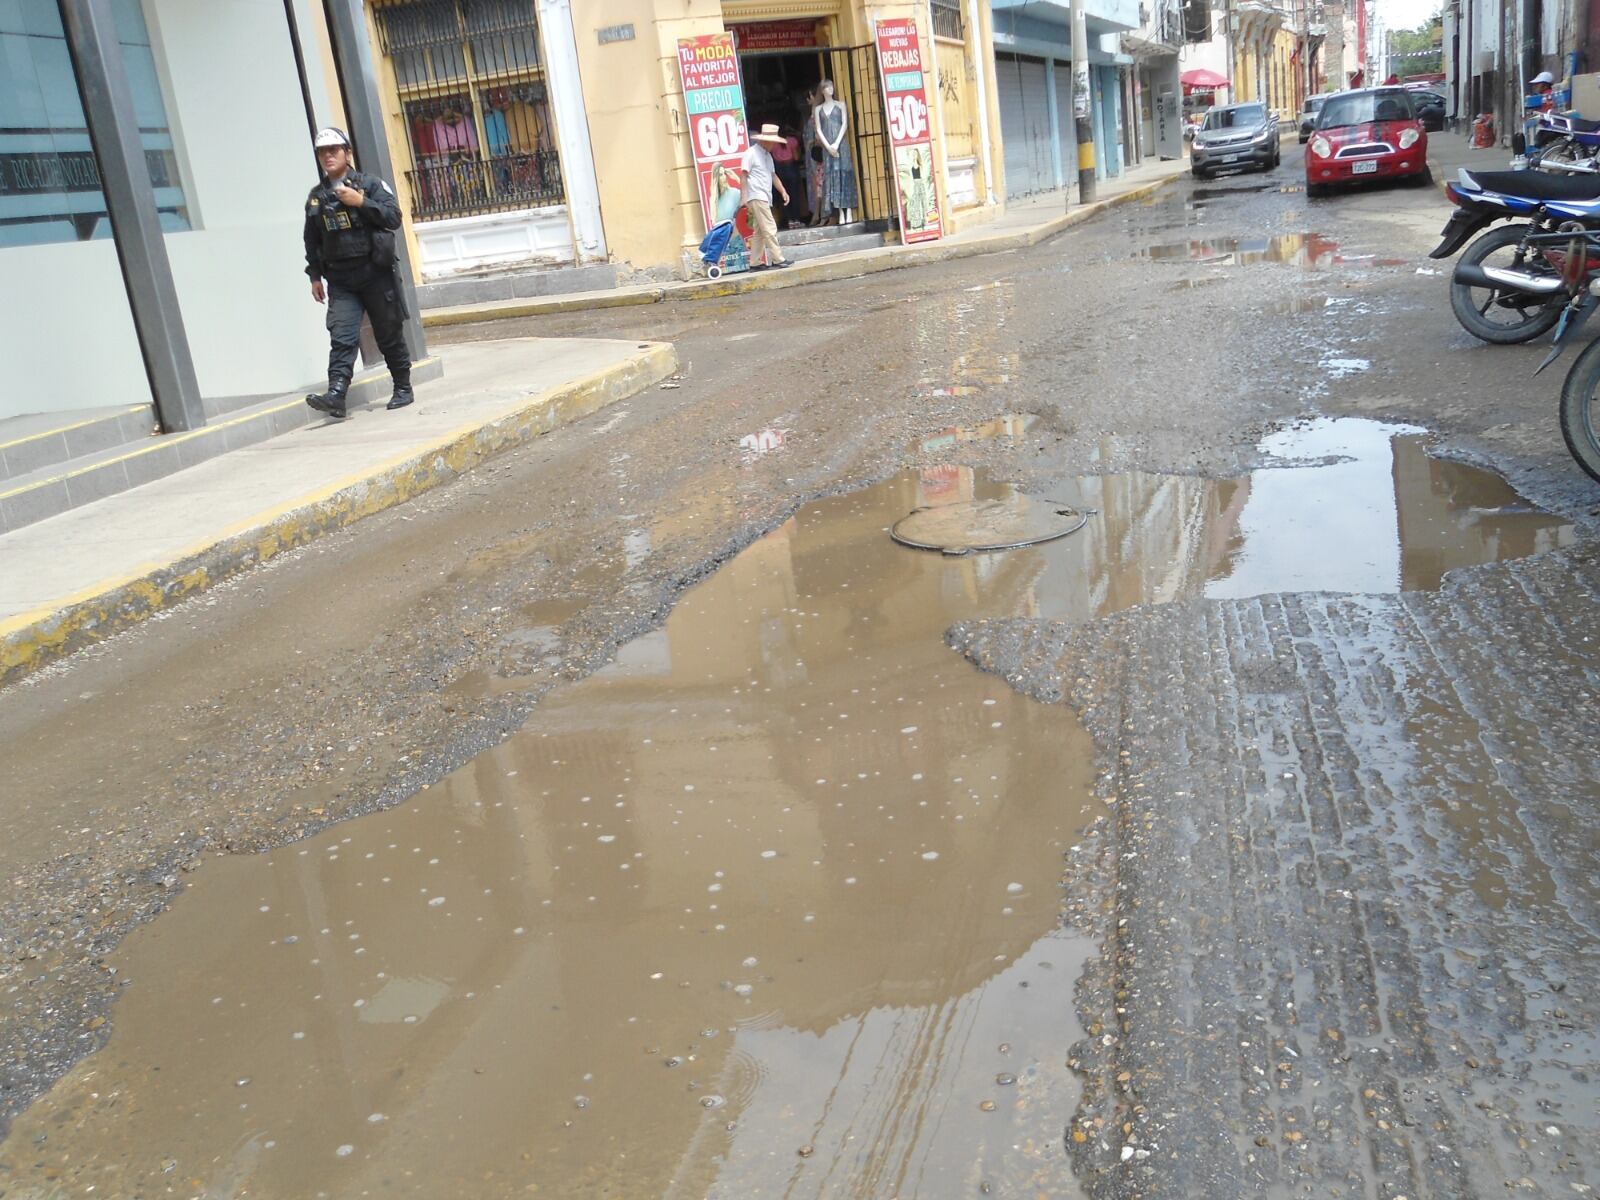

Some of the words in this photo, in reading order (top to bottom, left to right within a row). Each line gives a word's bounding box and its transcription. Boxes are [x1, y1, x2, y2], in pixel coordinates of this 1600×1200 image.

[695, 44, 734, 61] MODA
[882, 48, 919, 69] REBAJAS
[684, 58, 734, 74] FAVORITA
[685, 76, 699, 88] AL
[701, 71, 736, 86] MEJOR
[693, 89, 733, 111] PRECIO
